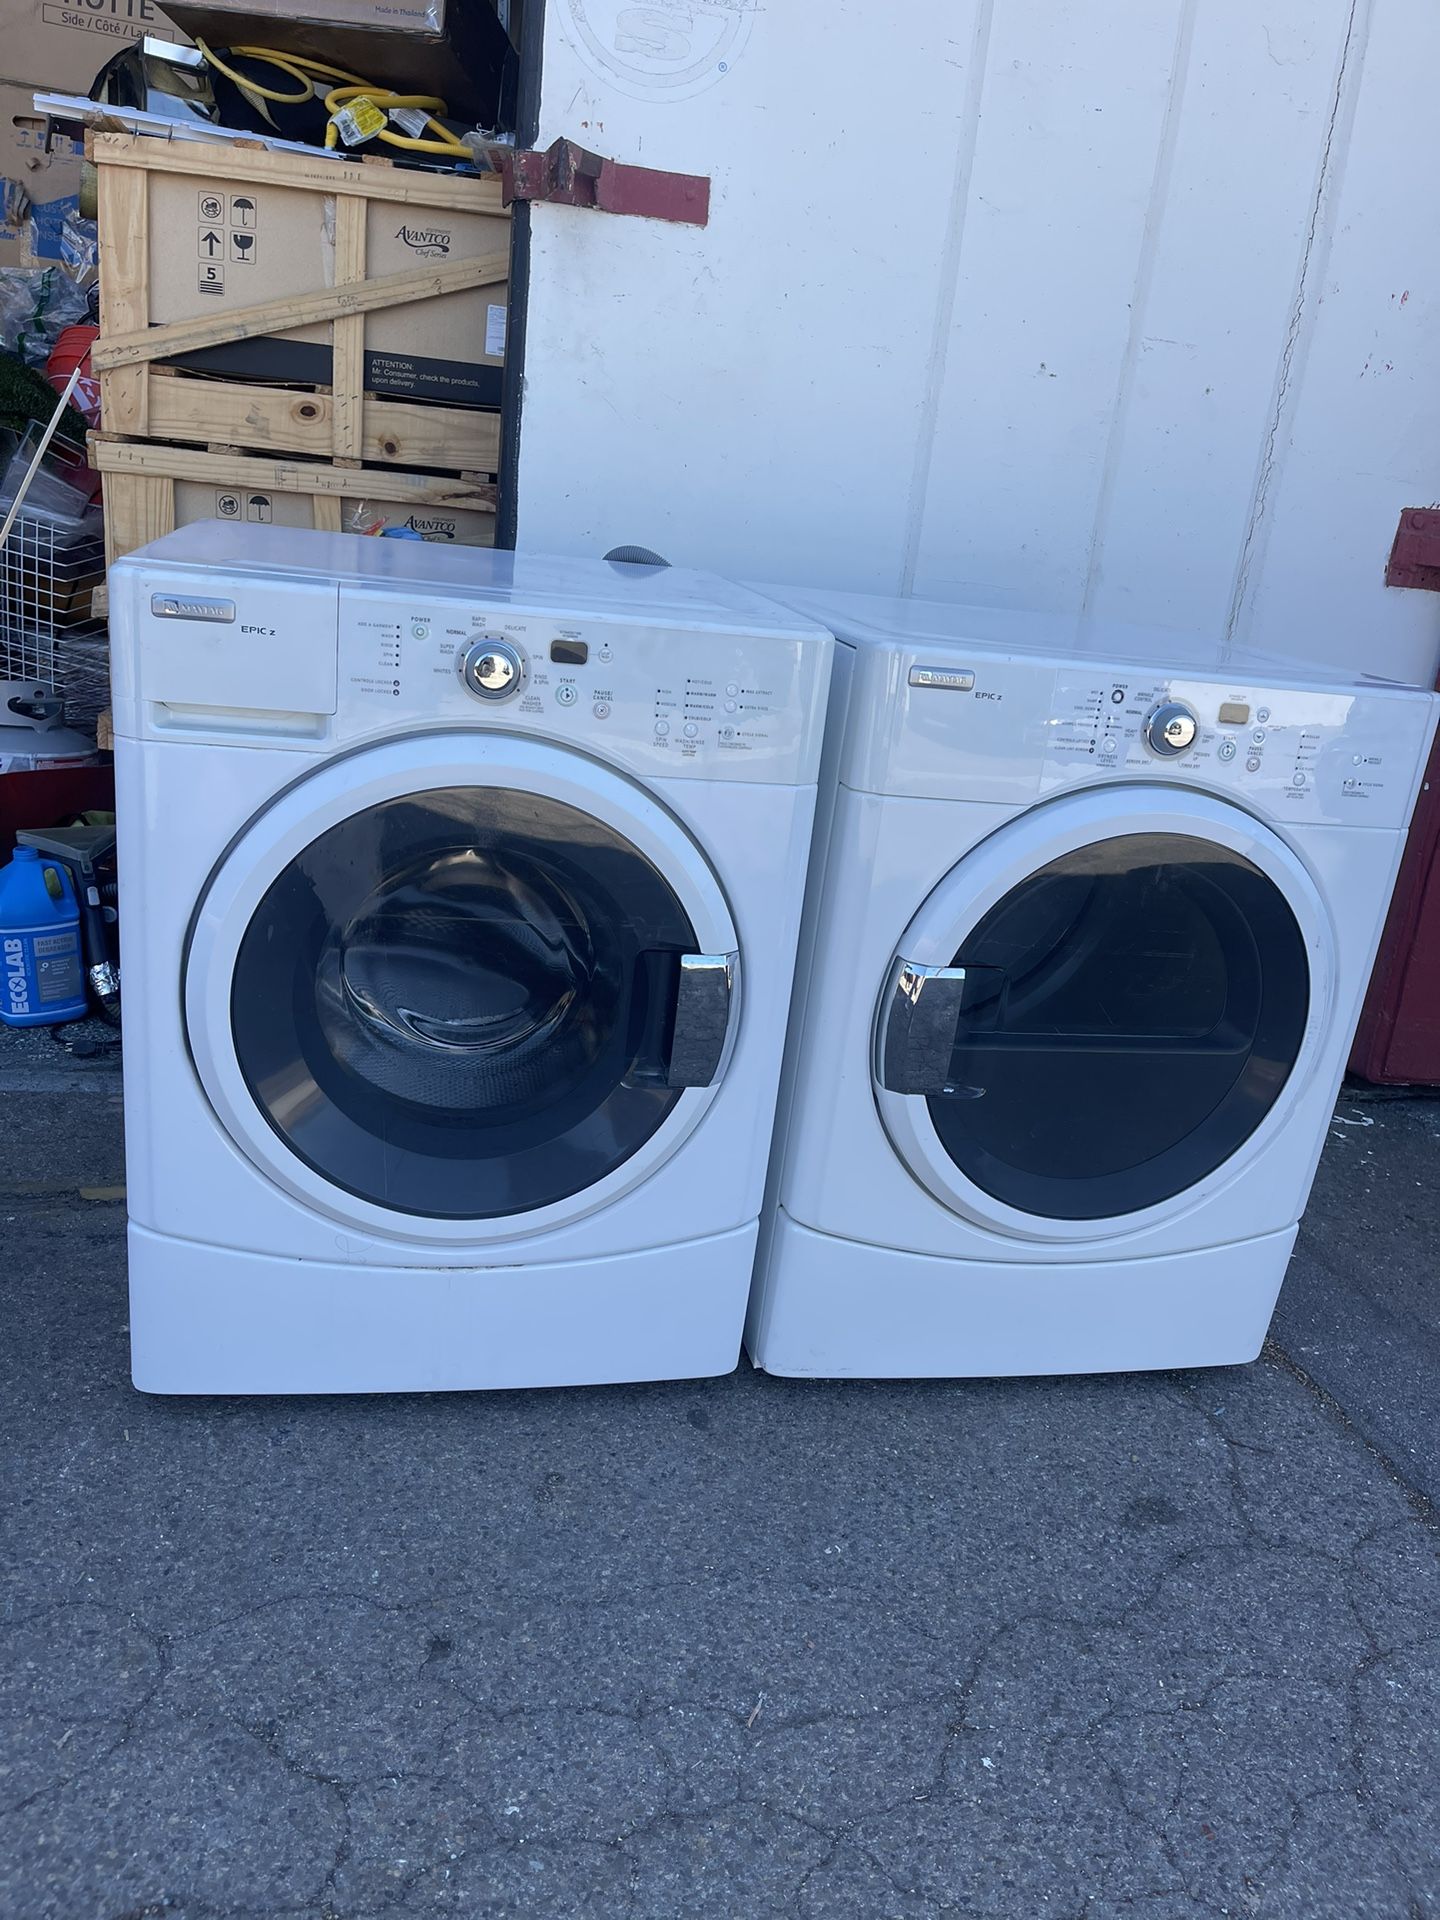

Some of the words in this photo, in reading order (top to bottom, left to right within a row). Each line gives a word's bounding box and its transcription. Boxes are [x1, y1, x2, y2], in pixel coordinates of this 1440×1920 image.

[63, 0, 154, 21] TTE
[375, 5, 391, 14] Made
[400, 8, 426, 17] Thailand
[61, 12, 85, 27] Side
[87, 17, 93, 28] /
[95, 19, 120, 35] Côté
[122, 25, 129, 36] /
[395, 225, 450, 245] AVANTCO
[415, 249, 430, 258] Chef
[430, 250, 447, 258] Series
[207, 266, 216, 280] 5
[371, 359, 415, 370] ATTENTION:
[371, 367, 381, 375] Mr.
[419, 374, 439, 382] check
[439, 375, 450, 383] the
[371, 377, 388, 385] upon
[389, 379, 415, 388] delivery.
[404, 515, 456, 531] AVANTCO
[241, 625, 267, 635] EPIC
[504, 624, 527, 632] DELICATE
[975, 692, 996, 700] EPIC
[4, 938, 30, 1013] ECOLAB
